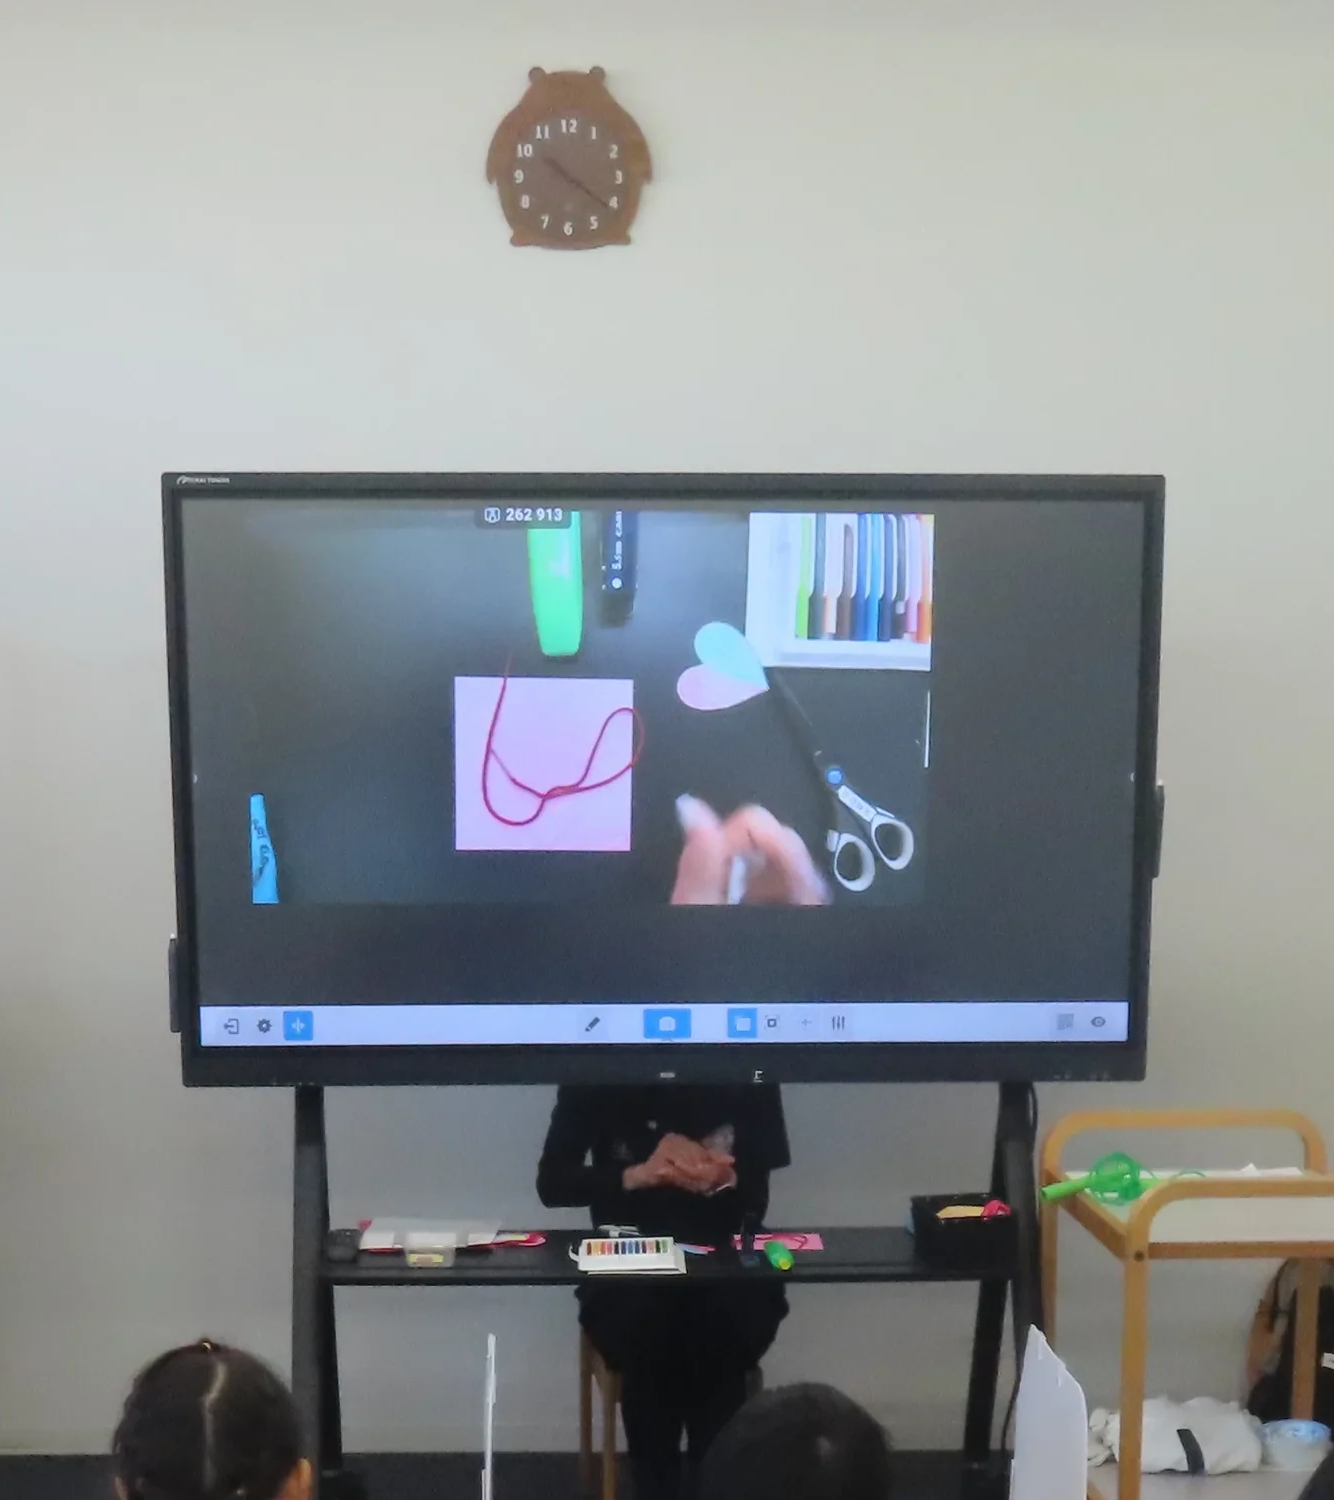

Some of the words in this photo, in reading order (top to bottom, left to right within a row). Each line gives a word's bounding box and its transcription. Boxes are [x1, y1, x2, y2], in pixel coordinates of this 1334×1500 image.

[535, 125, 550, 140] 11
[560, 118, 578, 133] 12
[591, 126, 597, 140] 1
[517, 143, 533, 158] 10
[609, 145, 618, 159] 2
[514, 169, 524, 183] 9
[615, 170, 623, 184] 3
[521, 195, 530, 209] 8
[609, 196, 618, 209] 4
[541, 215, 549, 229] 7
[563, 221, 573, 236] 6
[590, 216, 598, 230] 5
[505, 507, 533, 522] 262
[536, 507, 563, 522] 913
